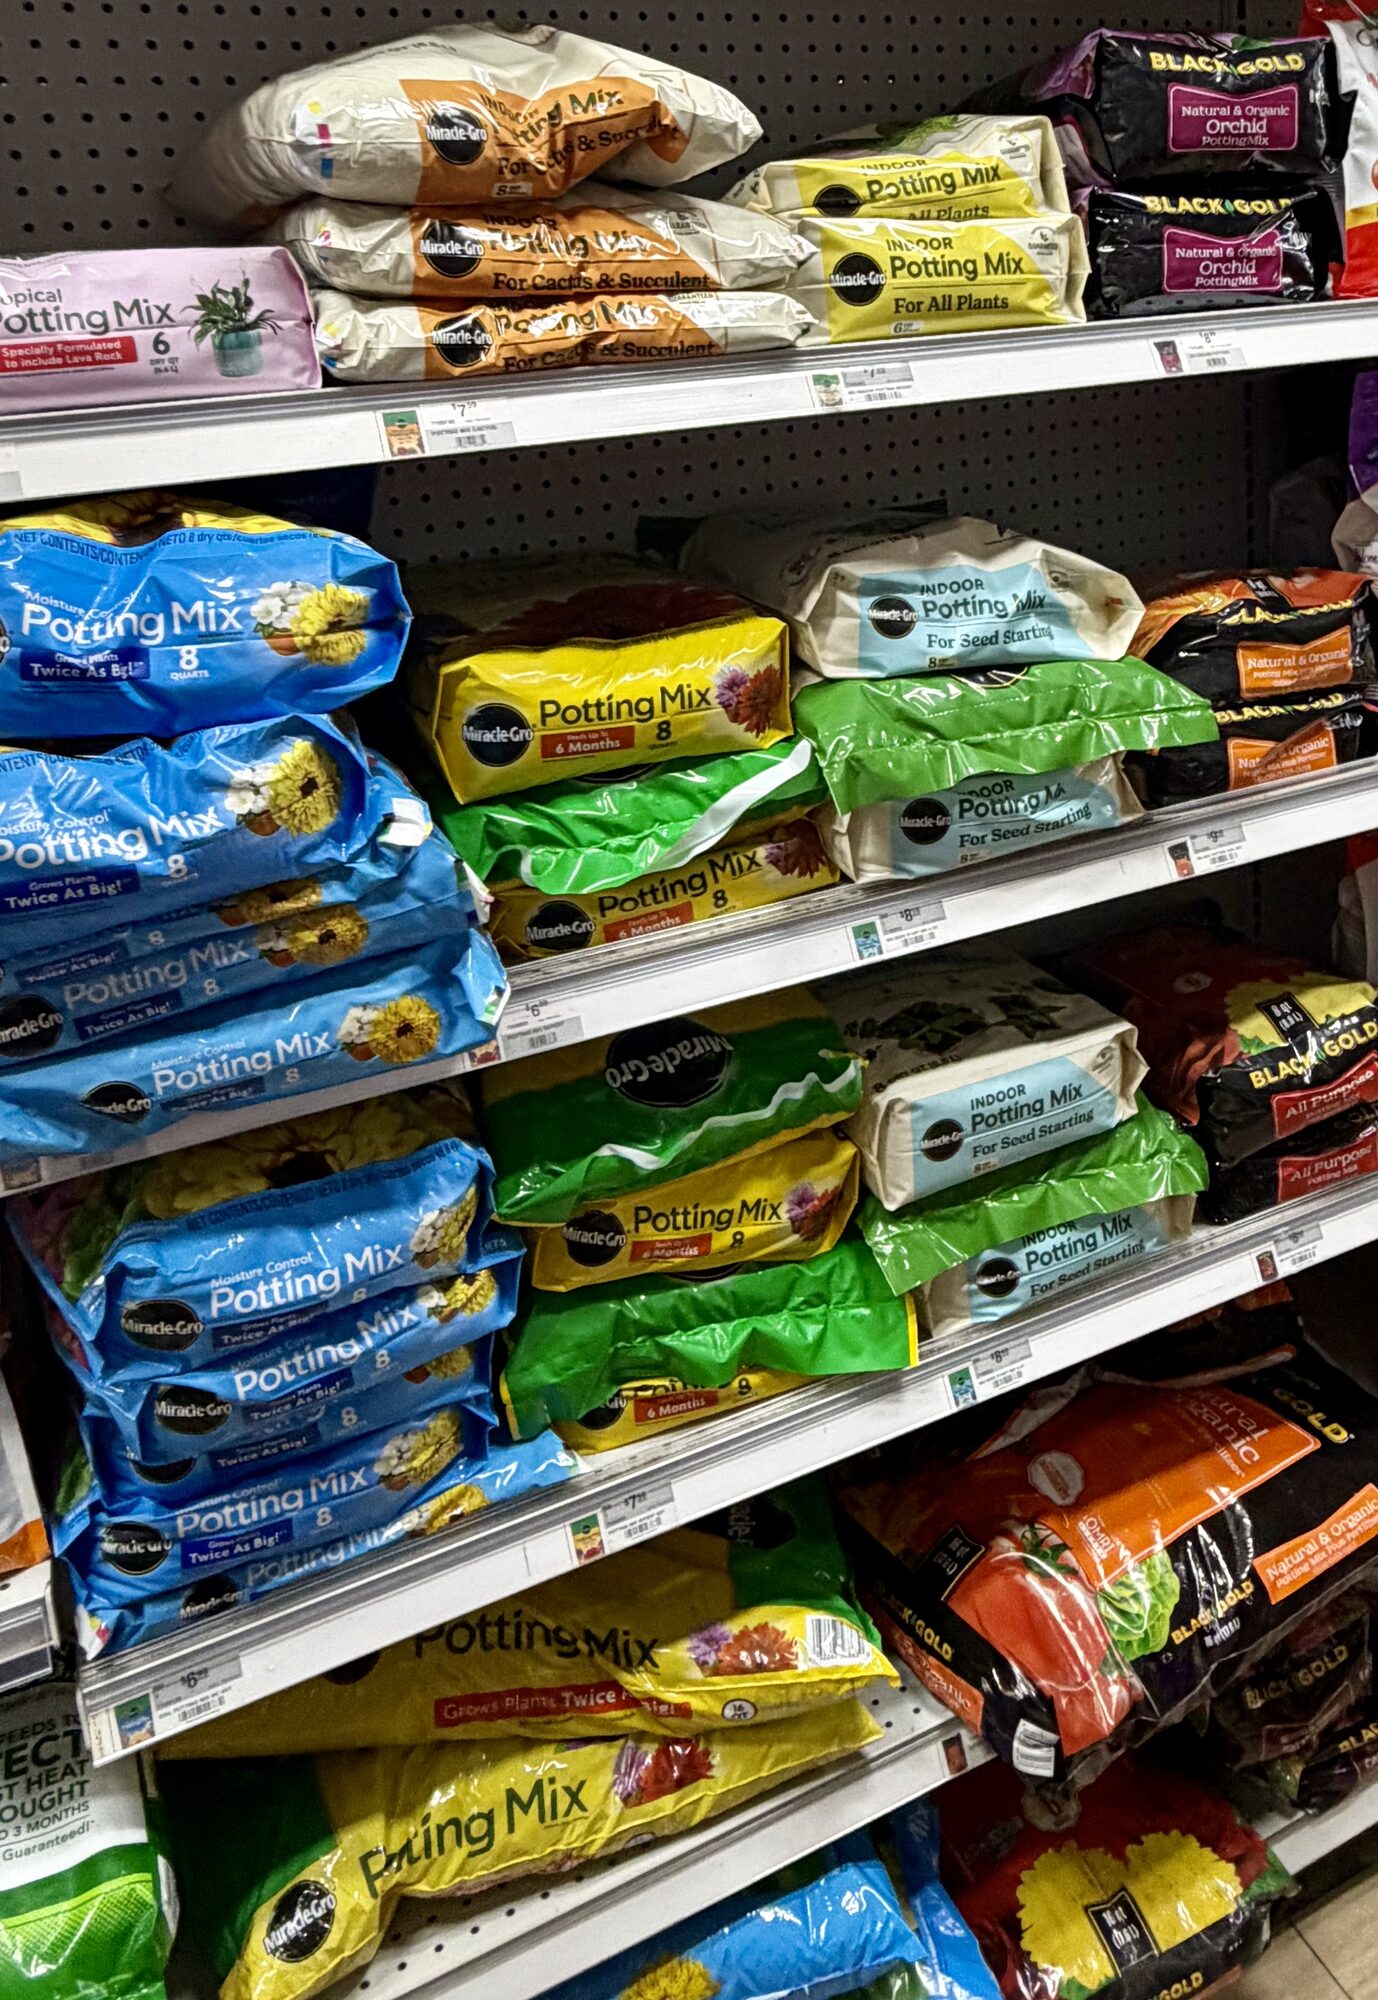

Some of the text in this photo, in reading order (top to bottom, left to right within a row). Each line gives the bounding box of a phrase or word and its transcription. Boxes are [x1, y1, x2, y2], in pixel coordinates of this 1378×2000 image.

[1150, 51, 1305, 76] BLACK GOLD
[568, 89, 624, 117] Mix
[1181, 104, 1290, 118] Natural & Organic
[426, 123, 488, 142] Miracle-Gro
[1206, 118, 1267, 134] Orchid
[498, 135, 596, 177] For &
[866, 163, 1003, 201] Potting Mix
[935, 203, 990, 220] Plants
[1144, 196, 1228, 215] BLACK
[420, 238, 486, 257] Miracle-Gro
[886, 236, 954, 252] INDOOR
[1175, 247, 1225, 259] Natural
[889, 251, 1025, 281] Potting Mix
[1199, 260, 1257, 275] Orchid
[493, 273, 528, 290] For
[597, 275, 615, 288] &
[619, 270, 711, 289] Succulent
[830, 273, 887, 287] Miracle-Gro
[112, 298, 176, 328] Mix
[893, 293, 1010, 314] For All Plants
[3, 340, 122, 359] Specially Formulated
[152, 331, 171, 355] 6
[432, 329, 494, 347] Miracle-Gro
[5, 351, 122, 368] to include Lava Rock
[503, 339, 715, 376] For Succulent
[14, 532, 36, 544] NET
[197, 531, 215, 546] dry
[919, 578, 984, 596] INDOOR
[26, 591, 86, 618] Moisture
[921, 588, 1048, 619] Potting Mix
[21, 601, 243, 646] Potting Mix
[926, 624, 1054, 649] For Seed Starting
[30, 663, 107, 679] Twice As
[180, 646, 200, 671] 8
[1248, 655, 1297, 669] Natural
[170, 669, 210, 681] QUARTS
[540, 683, 713, 728] Potting Mix
[462, 726, 535, 743] Miracle-Gro
[655, 719, 672, 741] 8
[555, 738, 621, 755] 6 Months
[957, 791, 1041, 820] Potting
[53, 811, 110, 830] Control
[148, 806, 225, 846] Mix
[900, 816, 951, 829] Miracle-Gro
[958, 802, 1092, 848] For Seed Starting
[166, 854, 188, 879] 8
[64, 874, 97, 886] Plants
[597, 872, 708, 919] Potting
[707, 849, 763, 885] Mix
[5, 880, 122, 910] Twice As Big!
[712, 888, 729, 909] 8
[526, 919, 596, 942] Miracle-Gro
[62, 958, 188, 1011] Potting
[186, 939, 251, 972] Mix
[203, 977, 220, 997] 8
[84, 1018, 124, 1036] Twice
[127, 1011, 144, 1024] As
[146, 1000, 172, 1018] Big!
[203, 1038, 247, 1058] Control
[1250, 1021, 1378, 1090] BLACK GOLD
[152, 1028, 333, 1097] Potting Mix
[605, 1033, 736, 1090] Miracle-Gro
[969, 1082, 1083, 1132] Potting Mix
[970, 1083, 1027, 1111] INDOOR
[1285, 1100, 1307, 1119] All
[972, 1107, 1095, 1159] For Seed Starting
[1290, 1144, 1373, 1183] All Purpose
[634, 1197, 783, 1234] Potting Mix
[562, 1226, 628, 1248] Miracle-Gro
[1020, 1221, 1077, 1248] INDOOR
[1024, 1213, 1134, 1272] Potting Mix
[210, 1252, 315, 1289] Moisture Control
[1029, 1236, 1146, 1297] For Seed Starting
[210, 1243, 405, 1320] Potting Mix
[120, 1316, 204, 1337] Miracle-Gro
[221, 1332, 264, 1346] Twice
[233, 1303, 419, 1402] Potting Mix
[375, 1349, 391, 1370] 8
[154, 1400, 232, 1418] Miracle-Gro
[251, 1382, 342, 1421] Twice As Big!
[341, 1406, 358, 1427] 8
[217, 1453, 258, 1469] Twice
[258, 1445, 279, 1457] As
[281, 1436, 308, 1452] Big!
[175, 1465, 369, 1538] Potting Mix
[315, 1506, 332, 1527] 8
[189, 1542, 251, 1564] Twice As
[248, 1541, 346, 1585] Potting
[1264, 1536, 1320, 1581] Natural
[415, 1607, 661, 1670] Potting Mix
[914, 1618, 953, 1662] GOLD
[560, 1688, 617, 1708] Twice
[25, 1759, 89, 1795] HEAT
[505, 1776, 589, 1835] Mix
[13, 1801, 90, 1838] 3 MONTHS
[2, 1820, 92, 1862] Guaranteed!
[263, 1892, 338, 1953] Miracle-Gro
